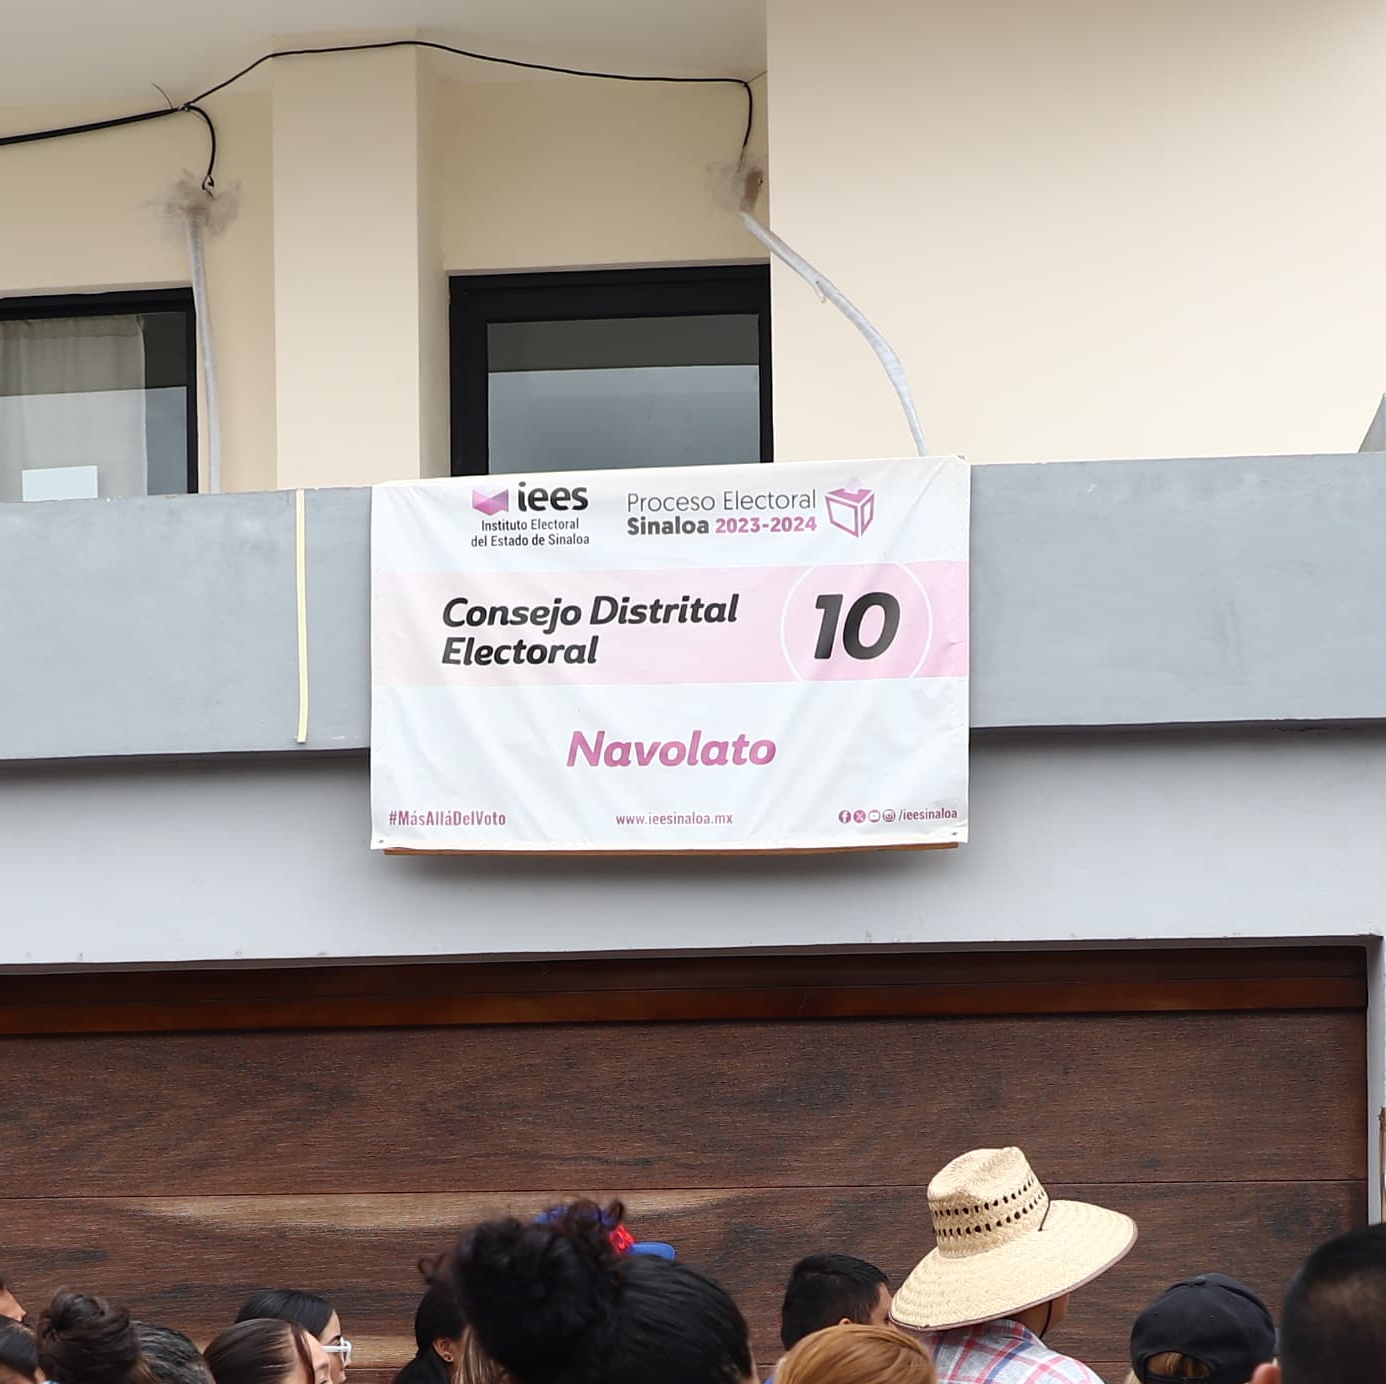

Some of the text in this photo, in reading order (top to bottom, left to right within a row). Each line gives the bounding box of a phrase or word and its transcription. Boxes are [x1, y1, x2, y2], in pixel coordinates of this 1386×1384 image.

[517, 481, 589, 512] iees
[627, 488, 816, 512] Proceso Electoral
[481, 517, 579, 532] Instituto Electoral
[626, 515, 817, 536] Sinaloa 2023-2024
[471, 532, 590, 548] del Estado de Sinaloa
[442, 593, 739, 634] Consejo Distrital
[813, 591, 901, 660] 10
[441, 635, 598, 666] Electoral
[566, 730, 776, 768] Navolato
[389, 808, 506, 828] #MásAlláDelVoto
[616, 811, 734, 826] www.ieesinaloa.mx
[898, 807, 958, 823] /ieesinaloa
